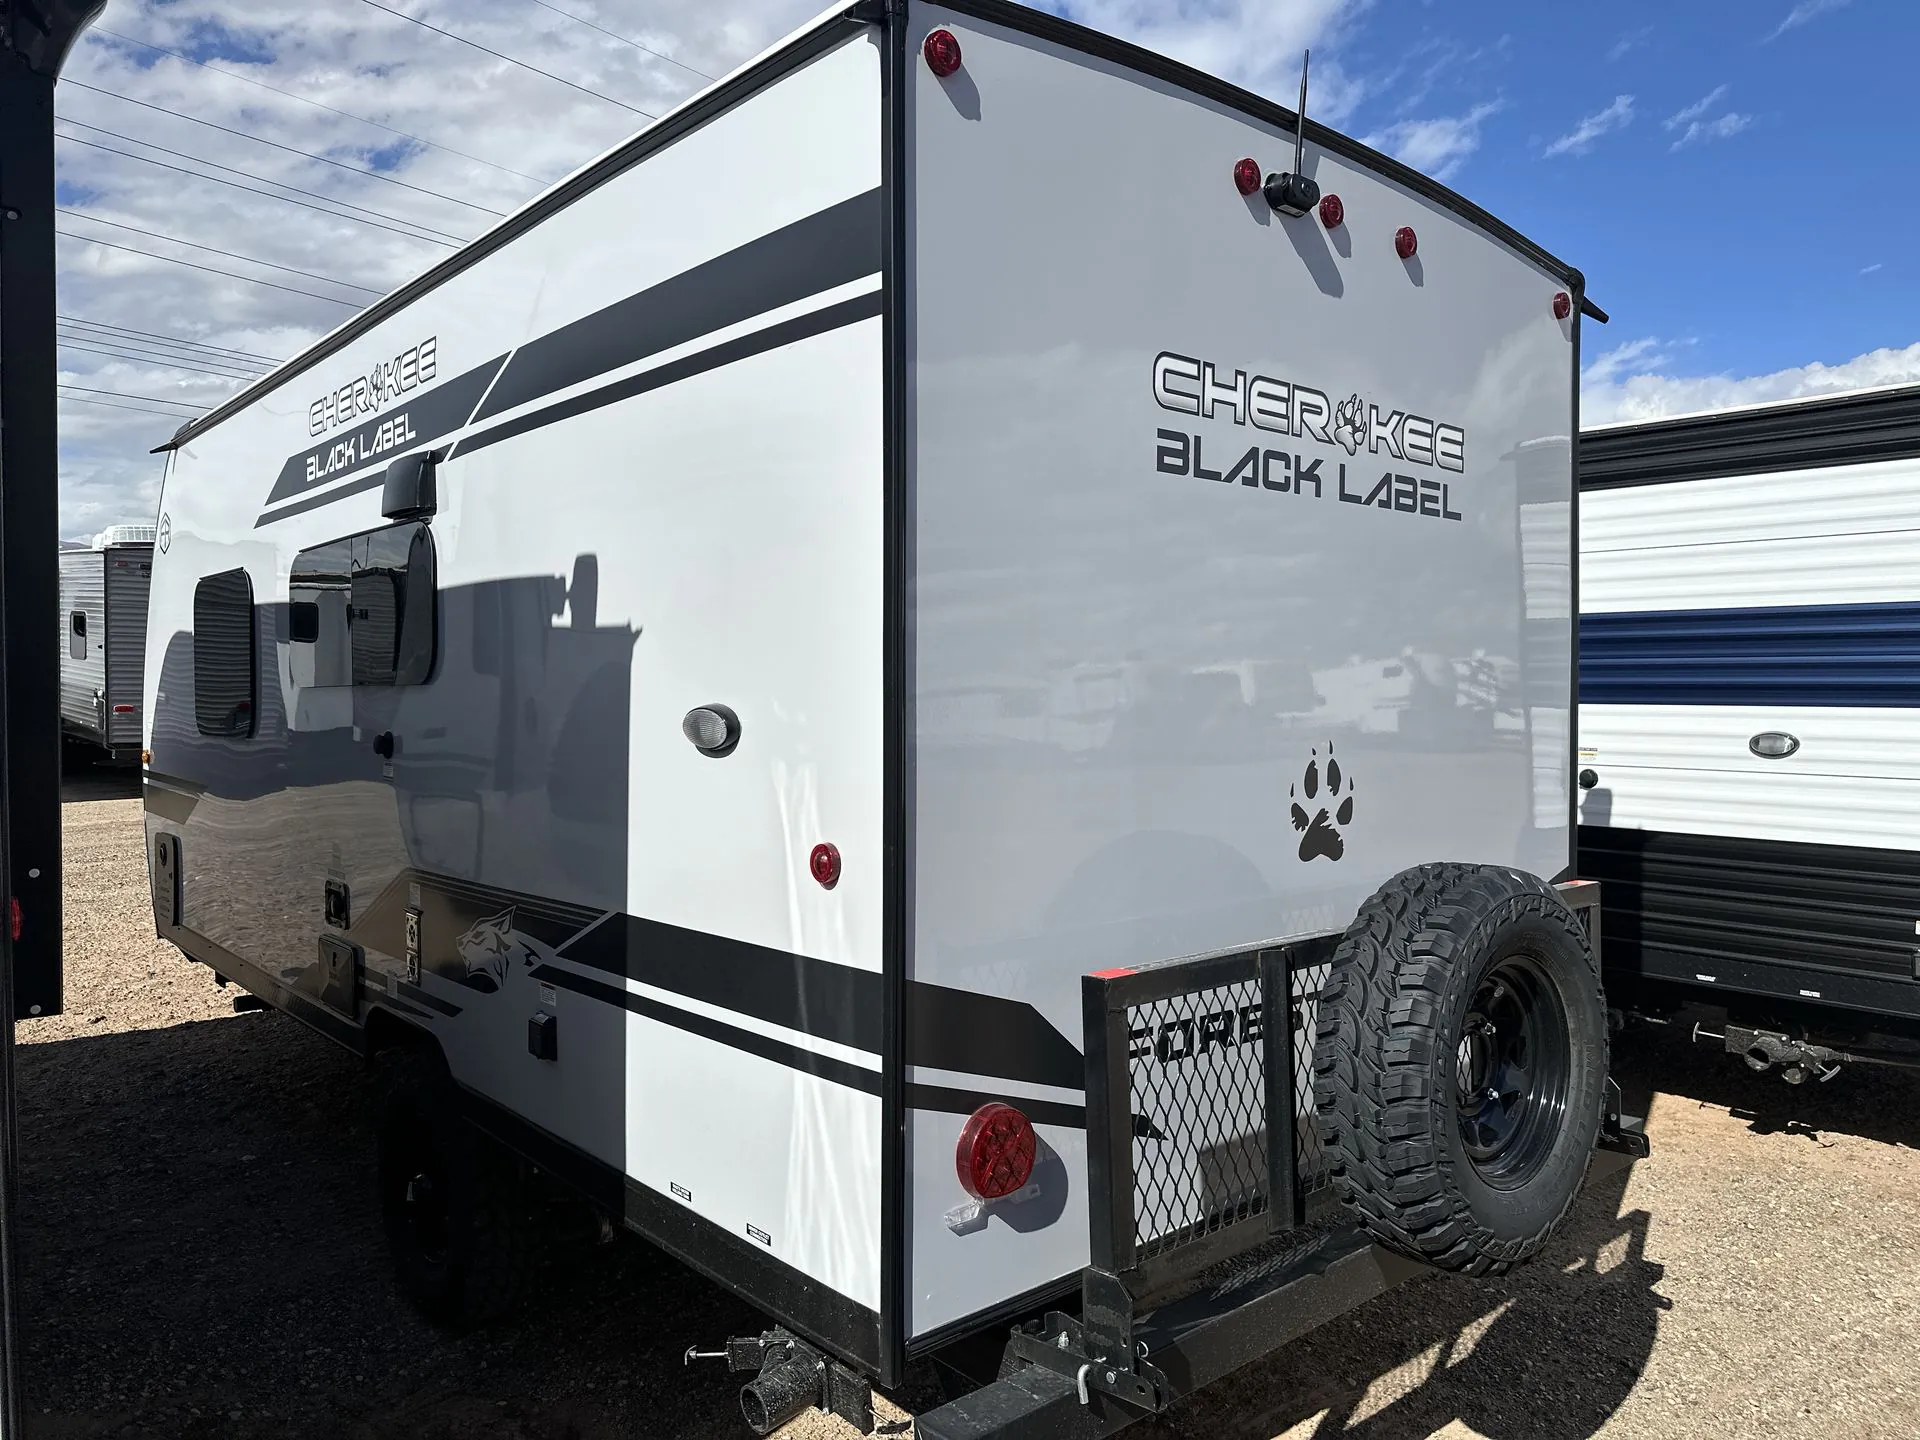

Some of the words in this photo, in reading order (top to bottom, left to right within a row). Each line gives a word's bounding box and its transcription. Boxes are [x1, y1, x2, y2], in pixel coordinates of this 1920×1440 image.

[306, 437, 356, 482] BLACK
[359, 412, 417, 461] LABEL
[1156, 428, 1325, 498] BLACK
[1338, 463, 1463, 522] LABEL
